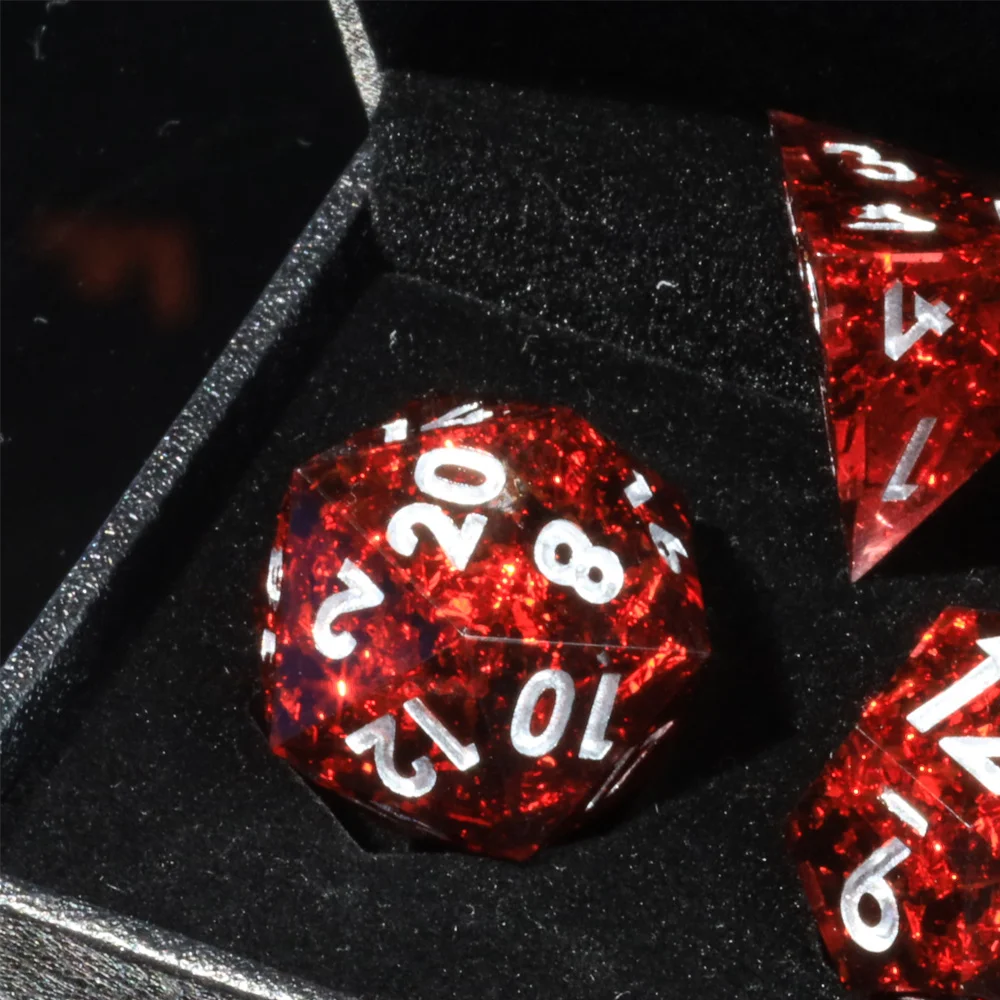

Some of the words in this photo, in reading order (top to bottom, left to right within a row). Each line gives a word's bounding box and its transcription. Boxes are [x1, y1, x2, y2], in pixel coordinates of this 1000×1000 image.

[824, 142, 917, 182] 3
[884, 280, 954, 361] 4
[882, 417, 937, 502] 1
[386, 446, 506, 571] 20
[534, 519, 624, 605] 8
[312, 558, 385, 660] 2
[345, 697, 480, 798] 12
[510, 668, 621, 761] 10
